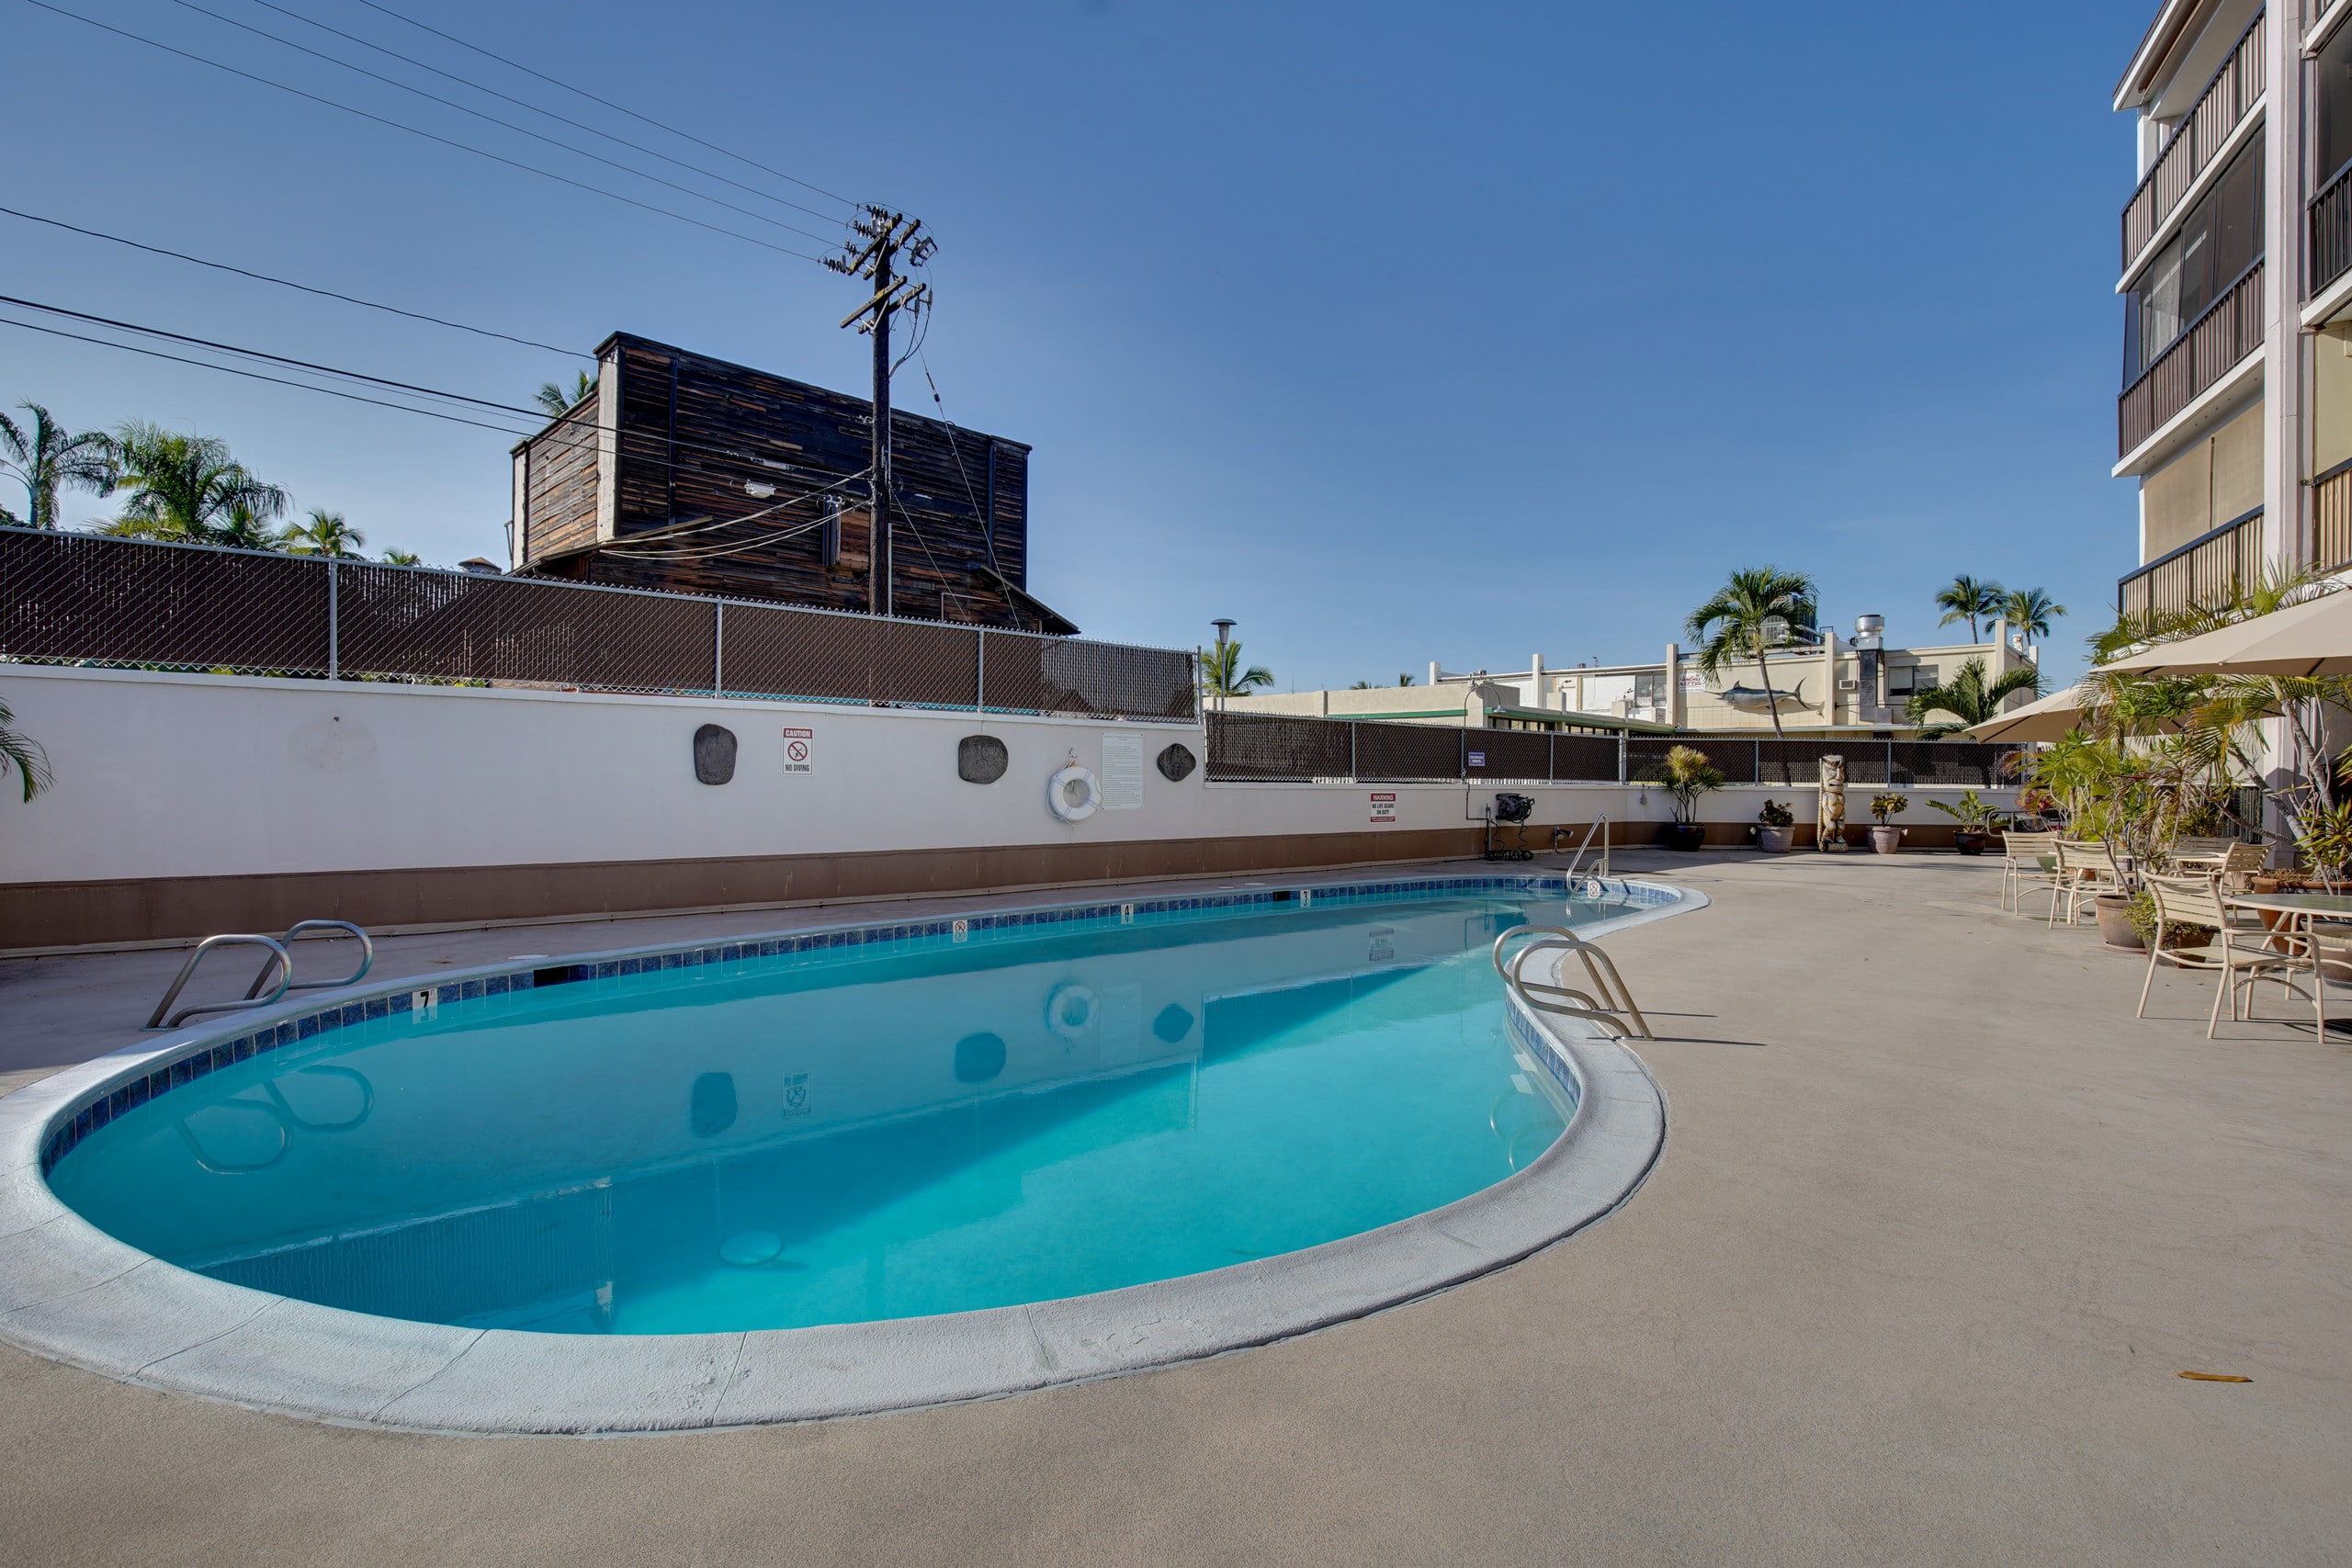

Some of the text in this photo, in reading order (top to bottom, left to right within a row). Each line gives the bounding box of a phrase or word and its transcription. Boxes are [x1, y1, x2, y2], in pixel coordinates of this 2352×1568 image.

[786, 729, 810, 738] CAUTION
[1125, 905, 1130, 915] 4
[420, 990, 430, 1009] 7
